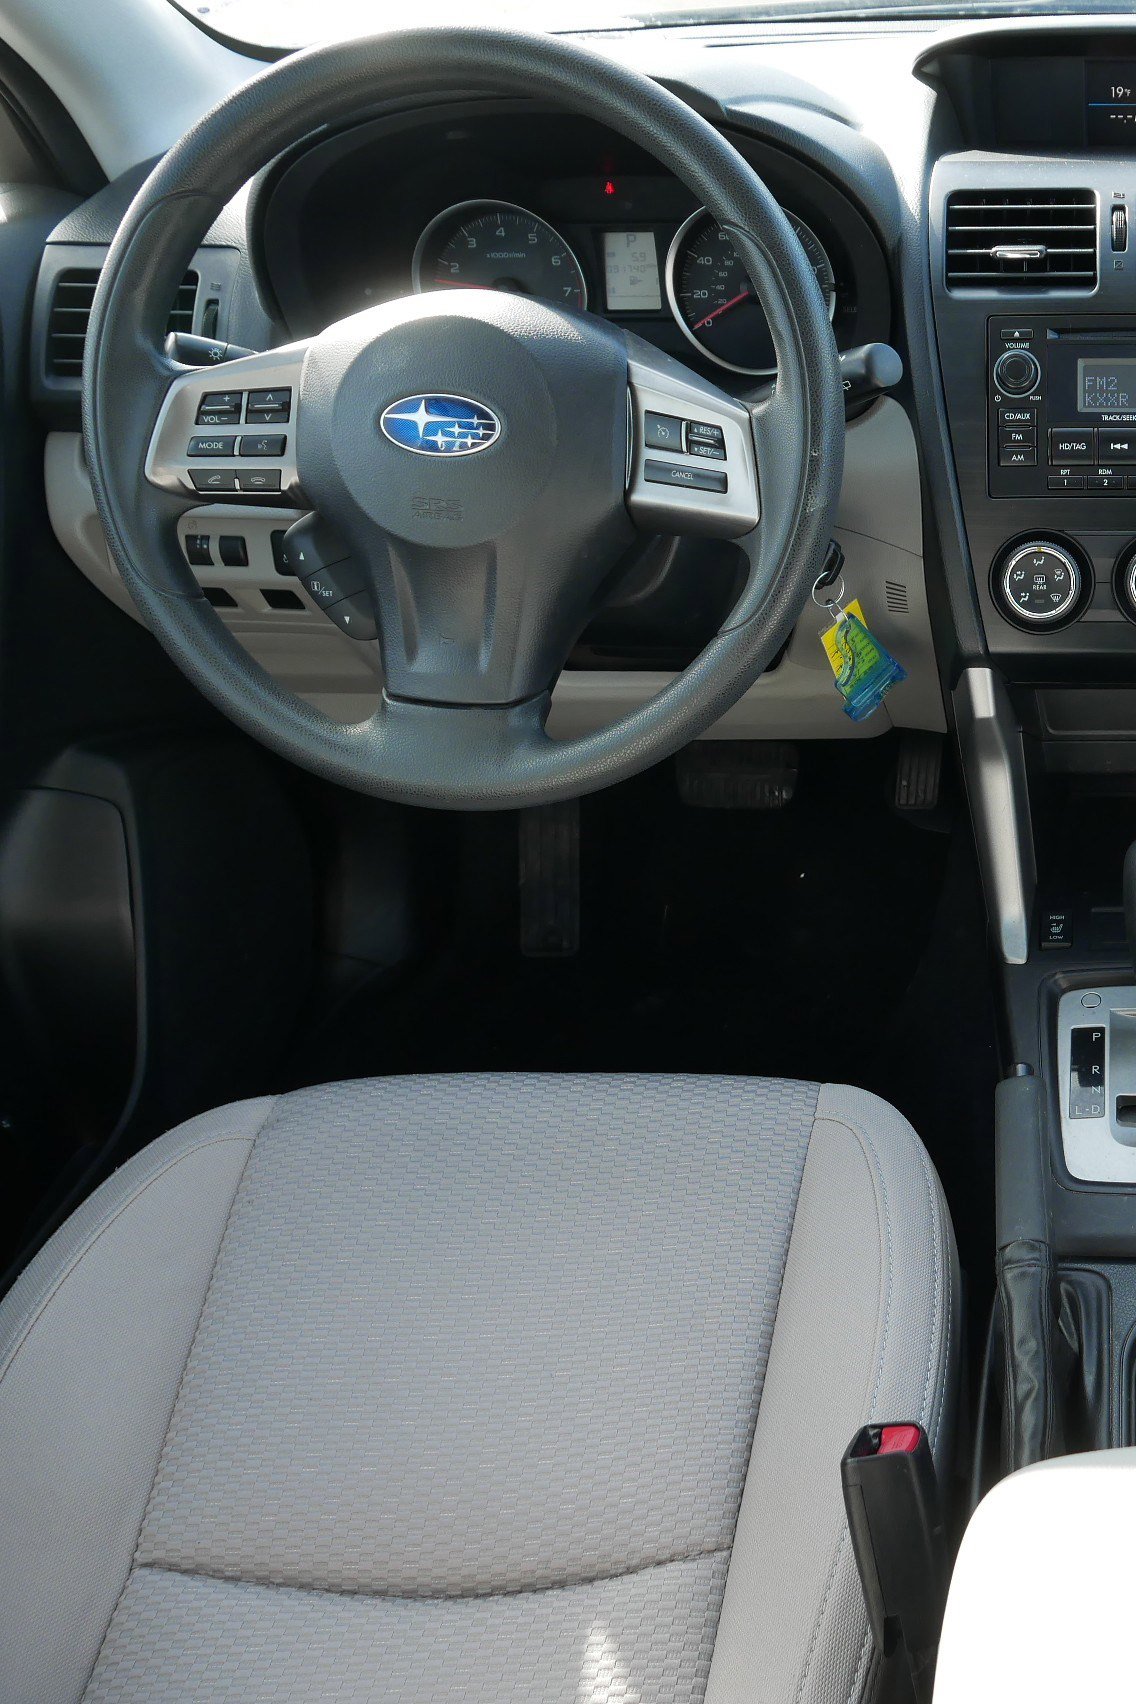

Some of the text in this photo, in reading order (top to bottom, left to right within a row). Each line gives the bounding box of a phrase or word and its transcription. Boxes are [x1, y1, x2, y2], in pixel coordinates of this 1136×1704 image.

[495, 227, 505, 237] 4
[468, 238, 477, 248] 3
[528, 233, 538, 244] 5
[626, 233, 637, 248] P
[551, 255, 561, 266] 6
[696, 256, 713, 265] 40
[450, 263, 460, 273] 2
[562, 287, 572, 297] 7
[693, 289, 709, 299] 20
[704, 318, 713, 327] 0
[1085, 376, 1118, 390] FM2
[1085, 392, 1129, 406] KXXR
[198, 441, 224, 449] MODE
[671, 470, 694, 480] CANCEL
[1092, 1033, 1101, 1041] P
[1091, 1066, 1100, 1074] R
